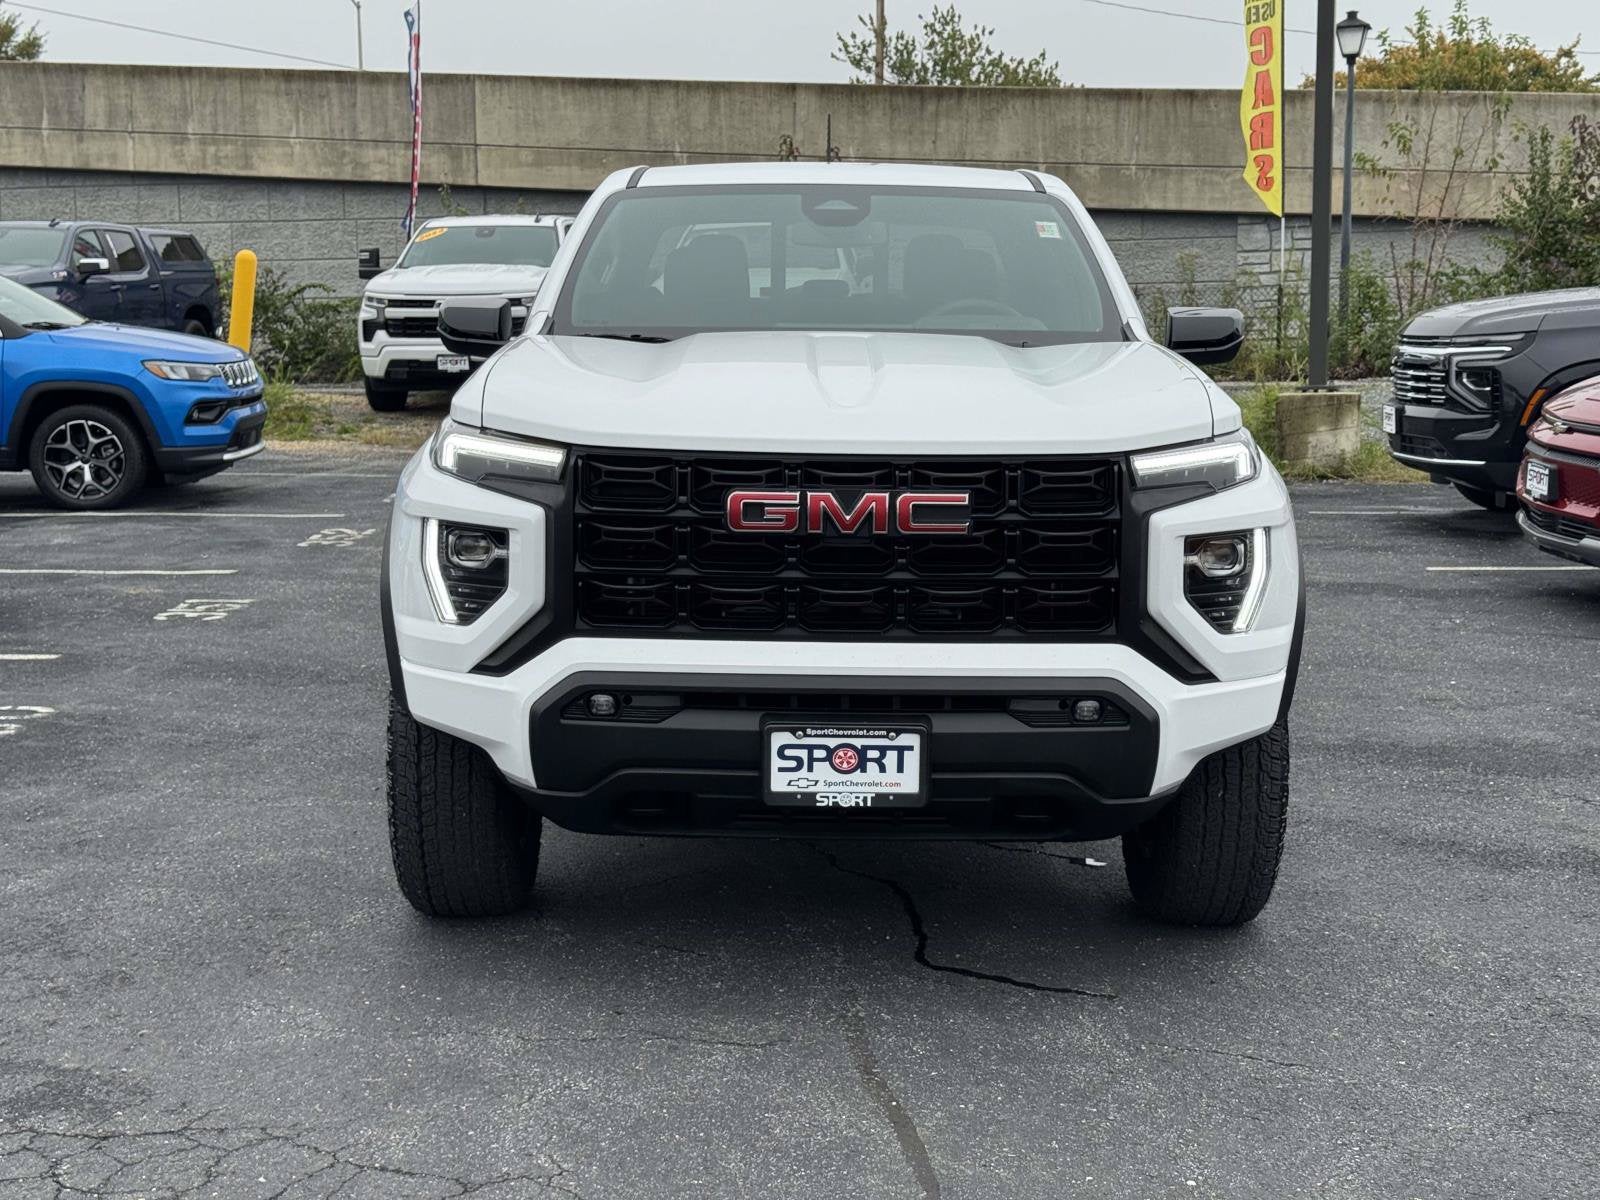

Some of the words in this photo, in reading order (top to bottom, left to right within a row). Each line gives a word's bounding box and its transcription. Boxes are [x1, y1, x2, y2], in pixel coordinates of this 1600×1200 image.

[727, 491, 970, 534] GMC
[806, 728, 887, 737] SportChevrolet.com
[777, 743, 914, 774] SPORT
[823, 779, 902, 788] SportChevrolet.com
[816, 792, 876, 807] SPORT
